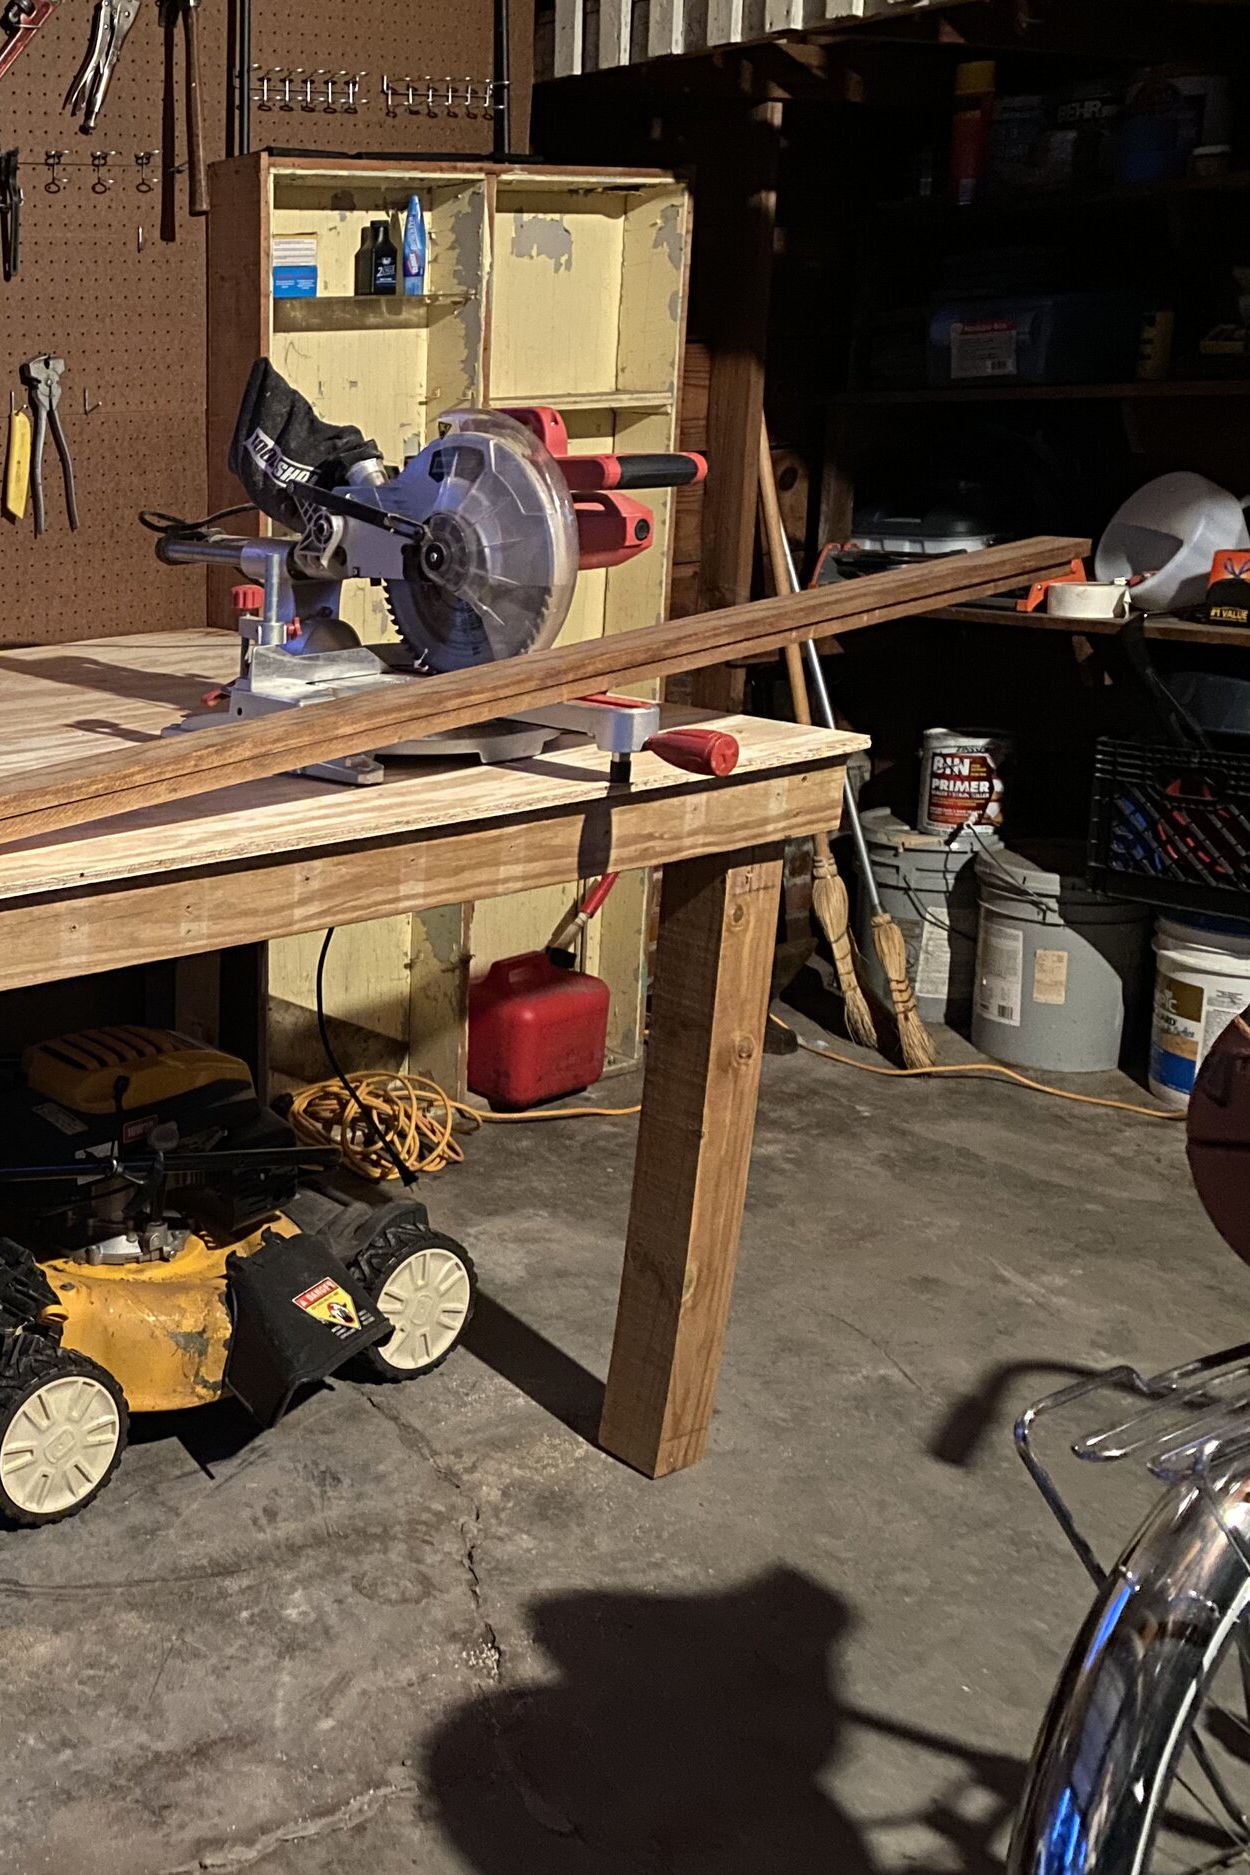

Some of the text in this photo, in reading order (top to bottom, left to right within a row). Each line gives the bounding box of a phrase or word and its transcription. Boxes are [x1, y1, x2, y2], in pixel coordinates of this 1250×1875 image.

[1223, 607, 1248, 620] VALUE
[933, 755, 970, 776] BIN
[931, 778, 990, 793] PRIMER
